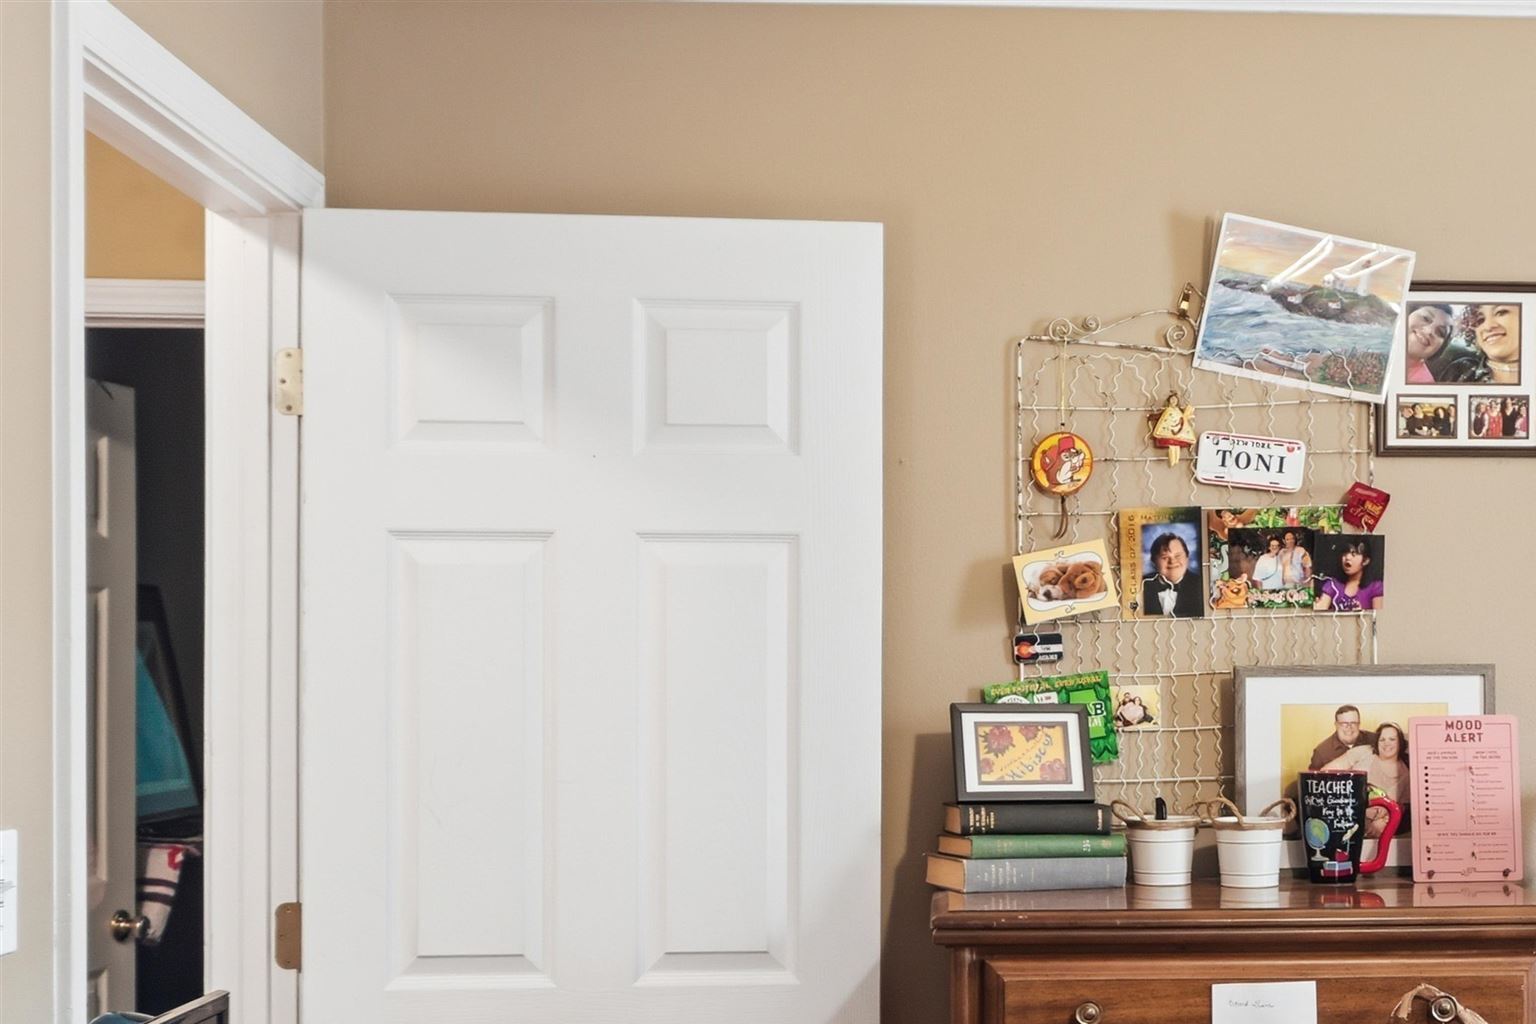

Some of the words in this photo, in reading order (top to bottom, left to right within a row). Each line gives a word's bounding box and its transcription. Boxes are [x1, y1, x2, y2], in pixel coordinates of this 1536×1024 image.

[1216, 449, 1287, 474] TONI
[1445, 720, 1482, 730] MOOD
[1444, 732, 1484, 743] ALERT
[1306, 780, 1354, 794] TEACHER
